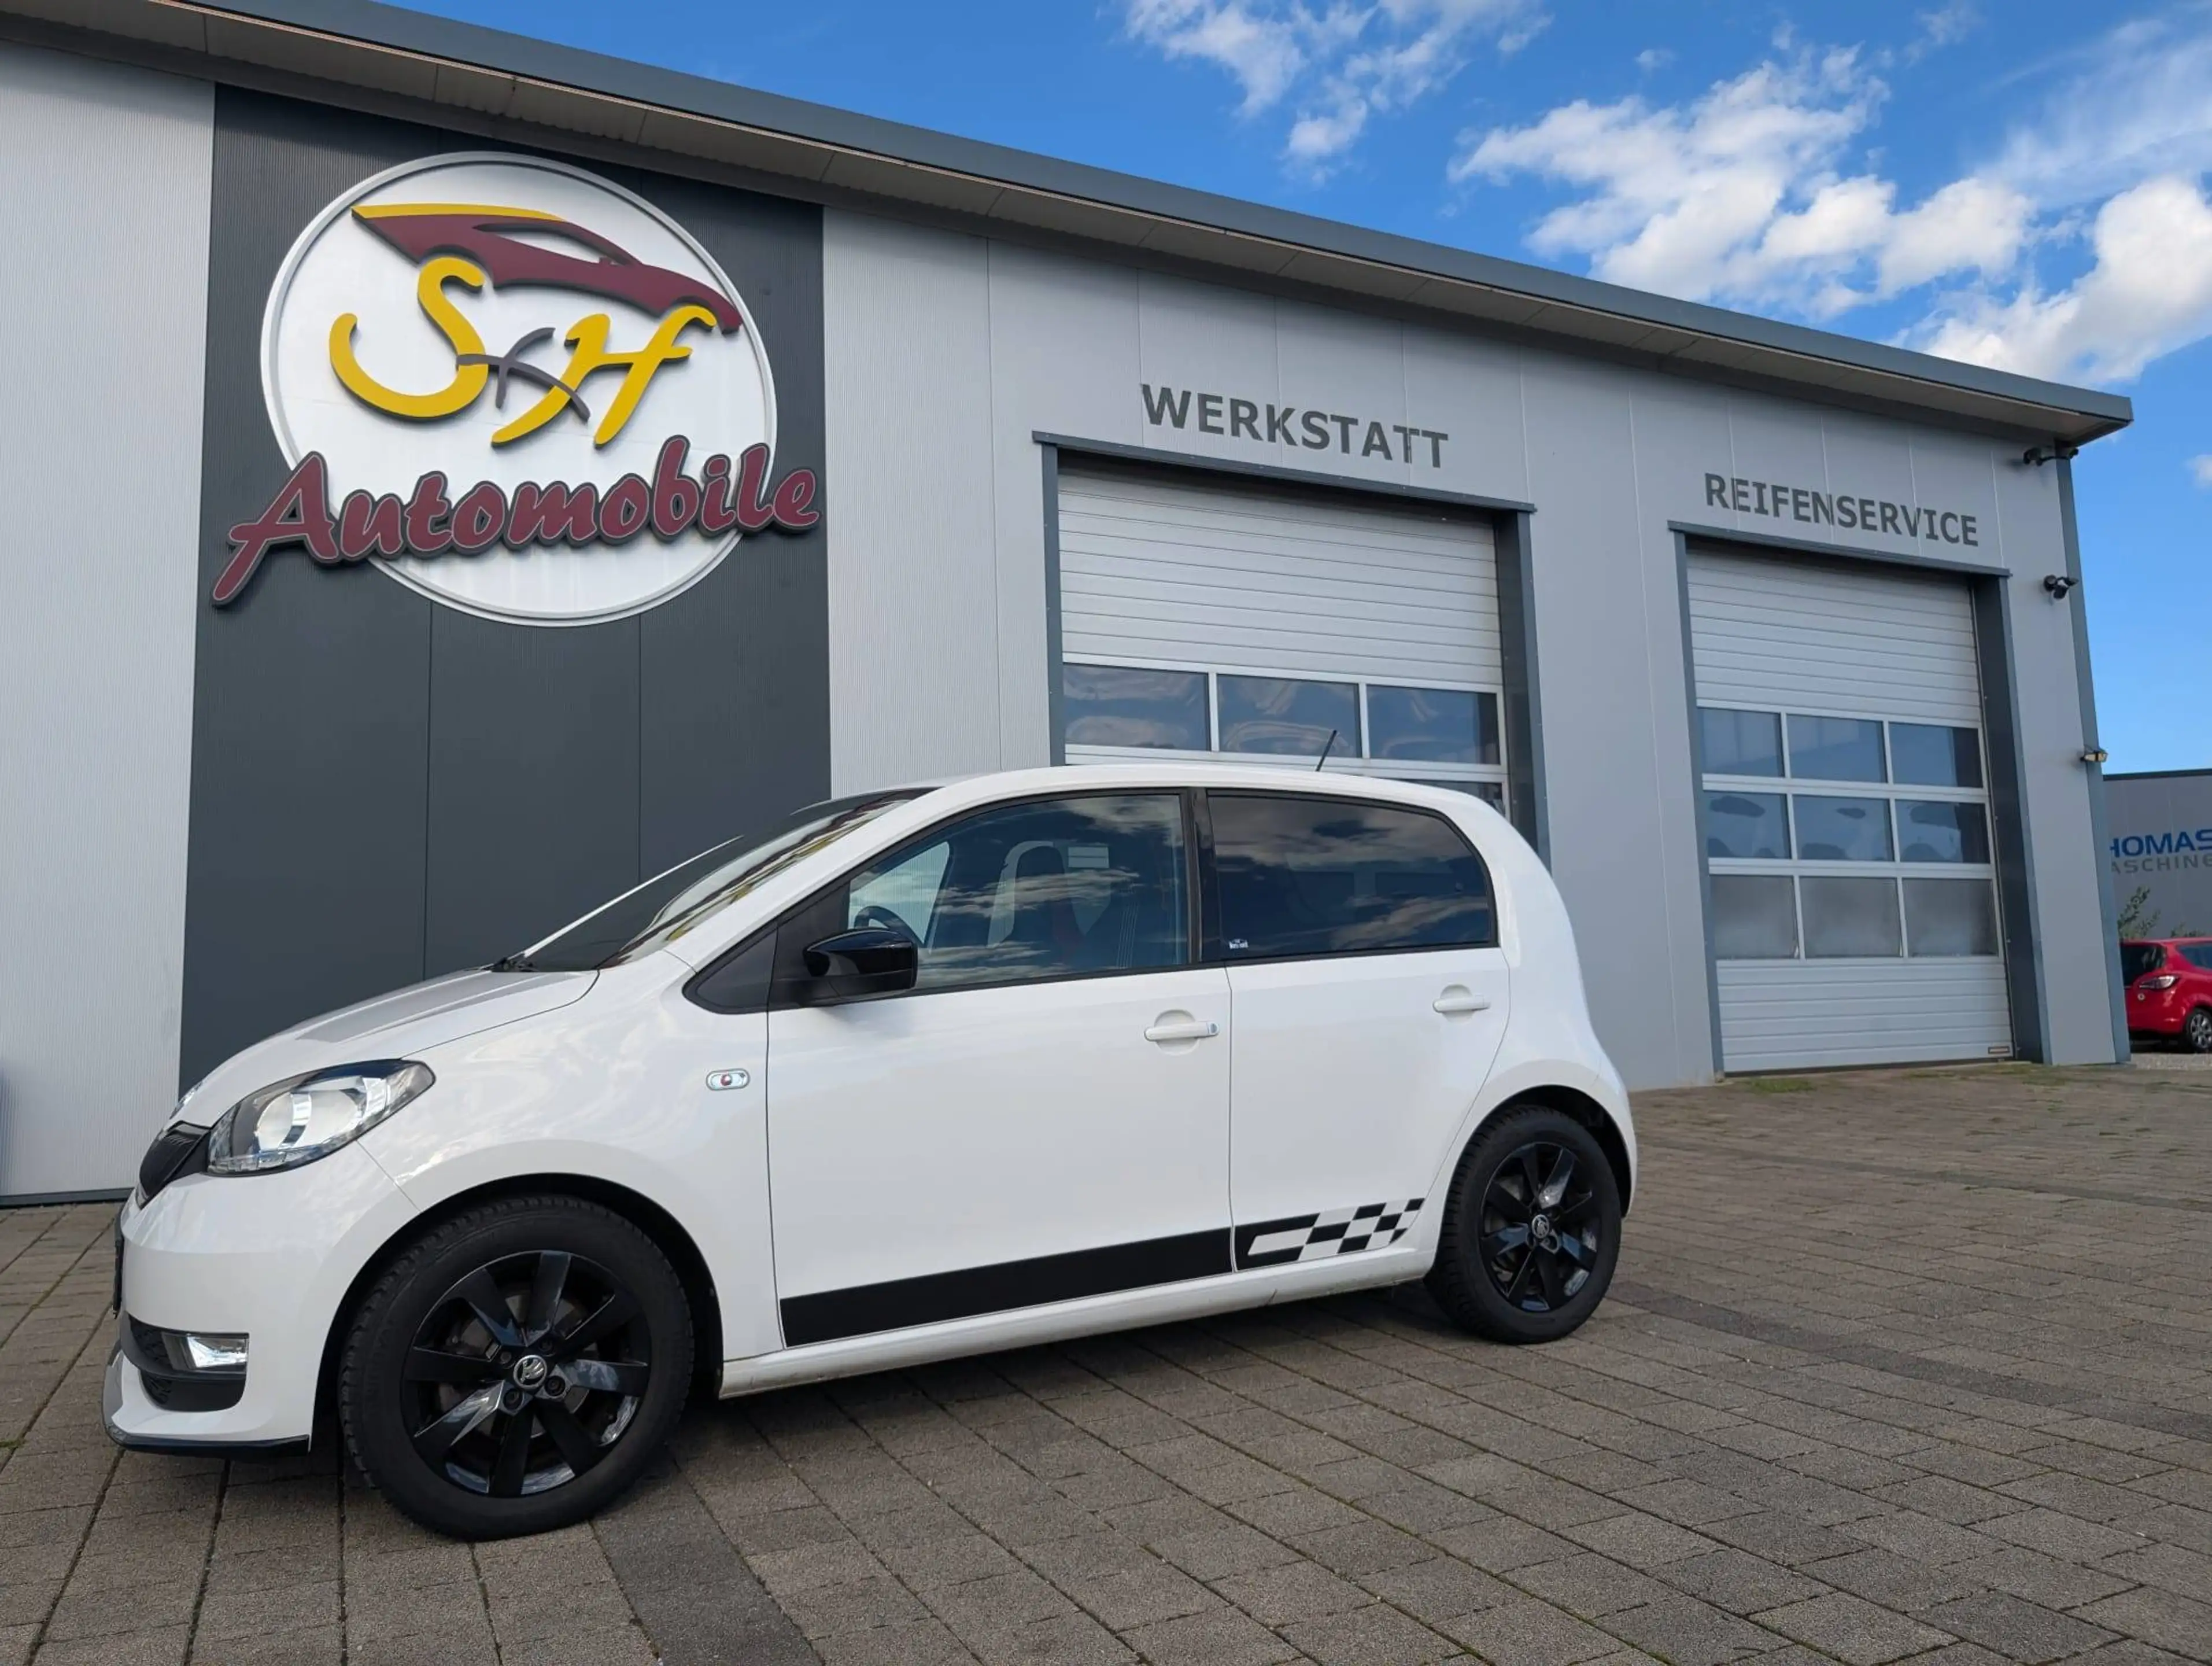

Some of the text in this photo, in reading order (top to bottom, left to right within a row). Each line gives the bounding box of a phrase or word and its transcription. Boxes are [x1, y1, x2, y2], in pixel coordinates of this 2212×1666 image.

[1141, 384, 1449, 469] WERKSTATT
[212, 434, 820, 606] Automobile
[1705, 473, 1979, 547] REIFENSERVICE
